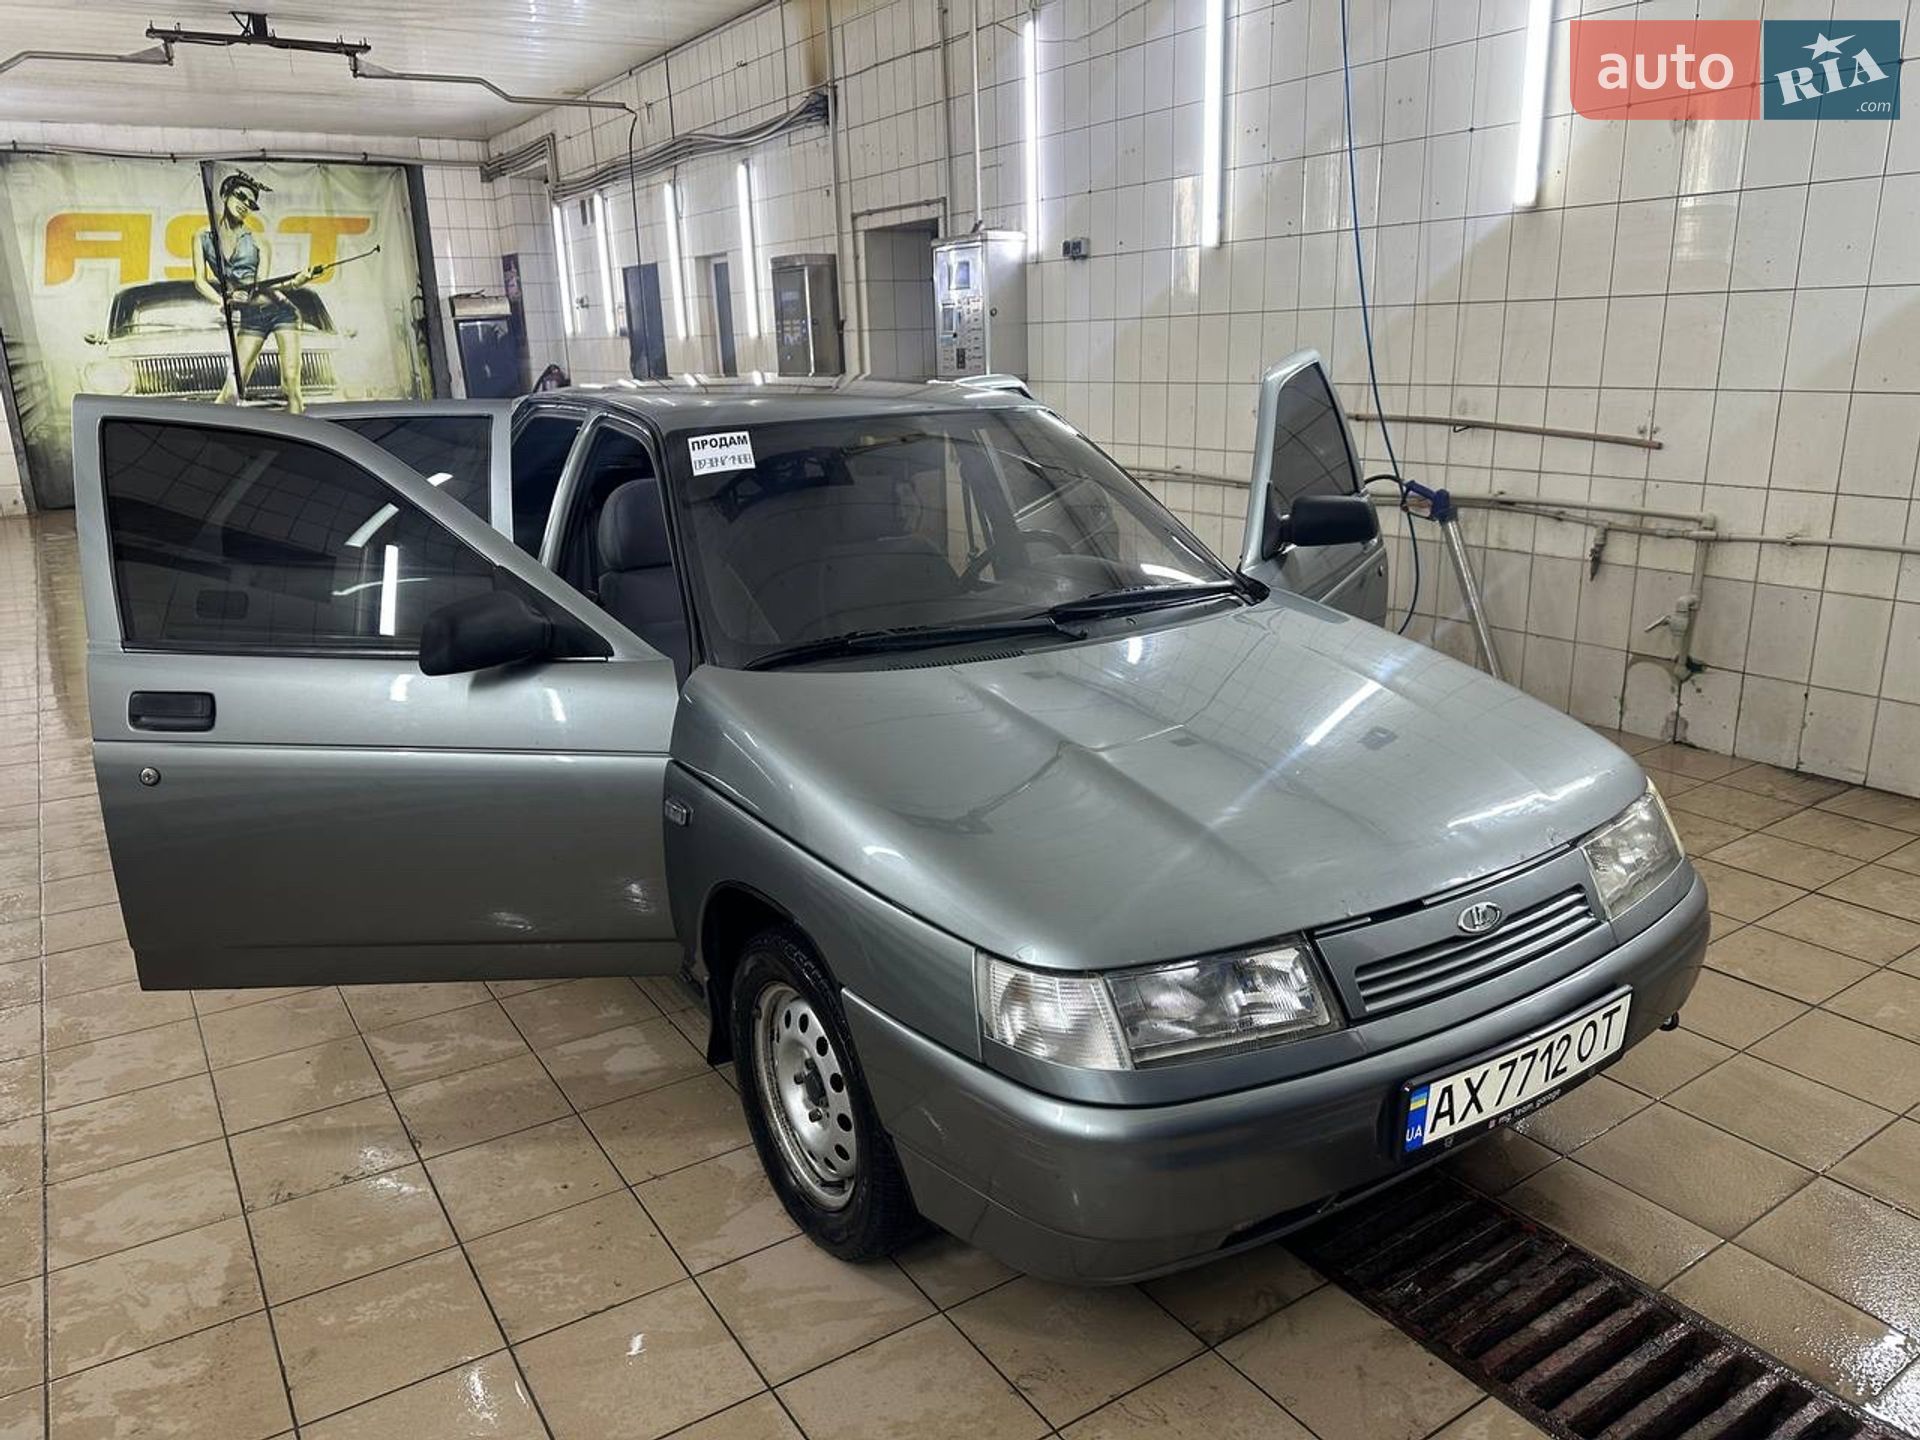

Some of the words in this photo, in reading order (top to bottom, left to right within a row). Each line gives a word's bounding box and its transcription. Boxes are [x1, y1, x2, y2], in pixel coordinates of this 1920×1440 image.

[691, 435, 749, 451] ПРОДАМ
[1429, 1069, 1490, 1134] AX
[1494, 1033, 1572, 1107] 7712
[1577, 1005, 1622, 1064] OT
[1405, 1126, 1424, 1143] UA
